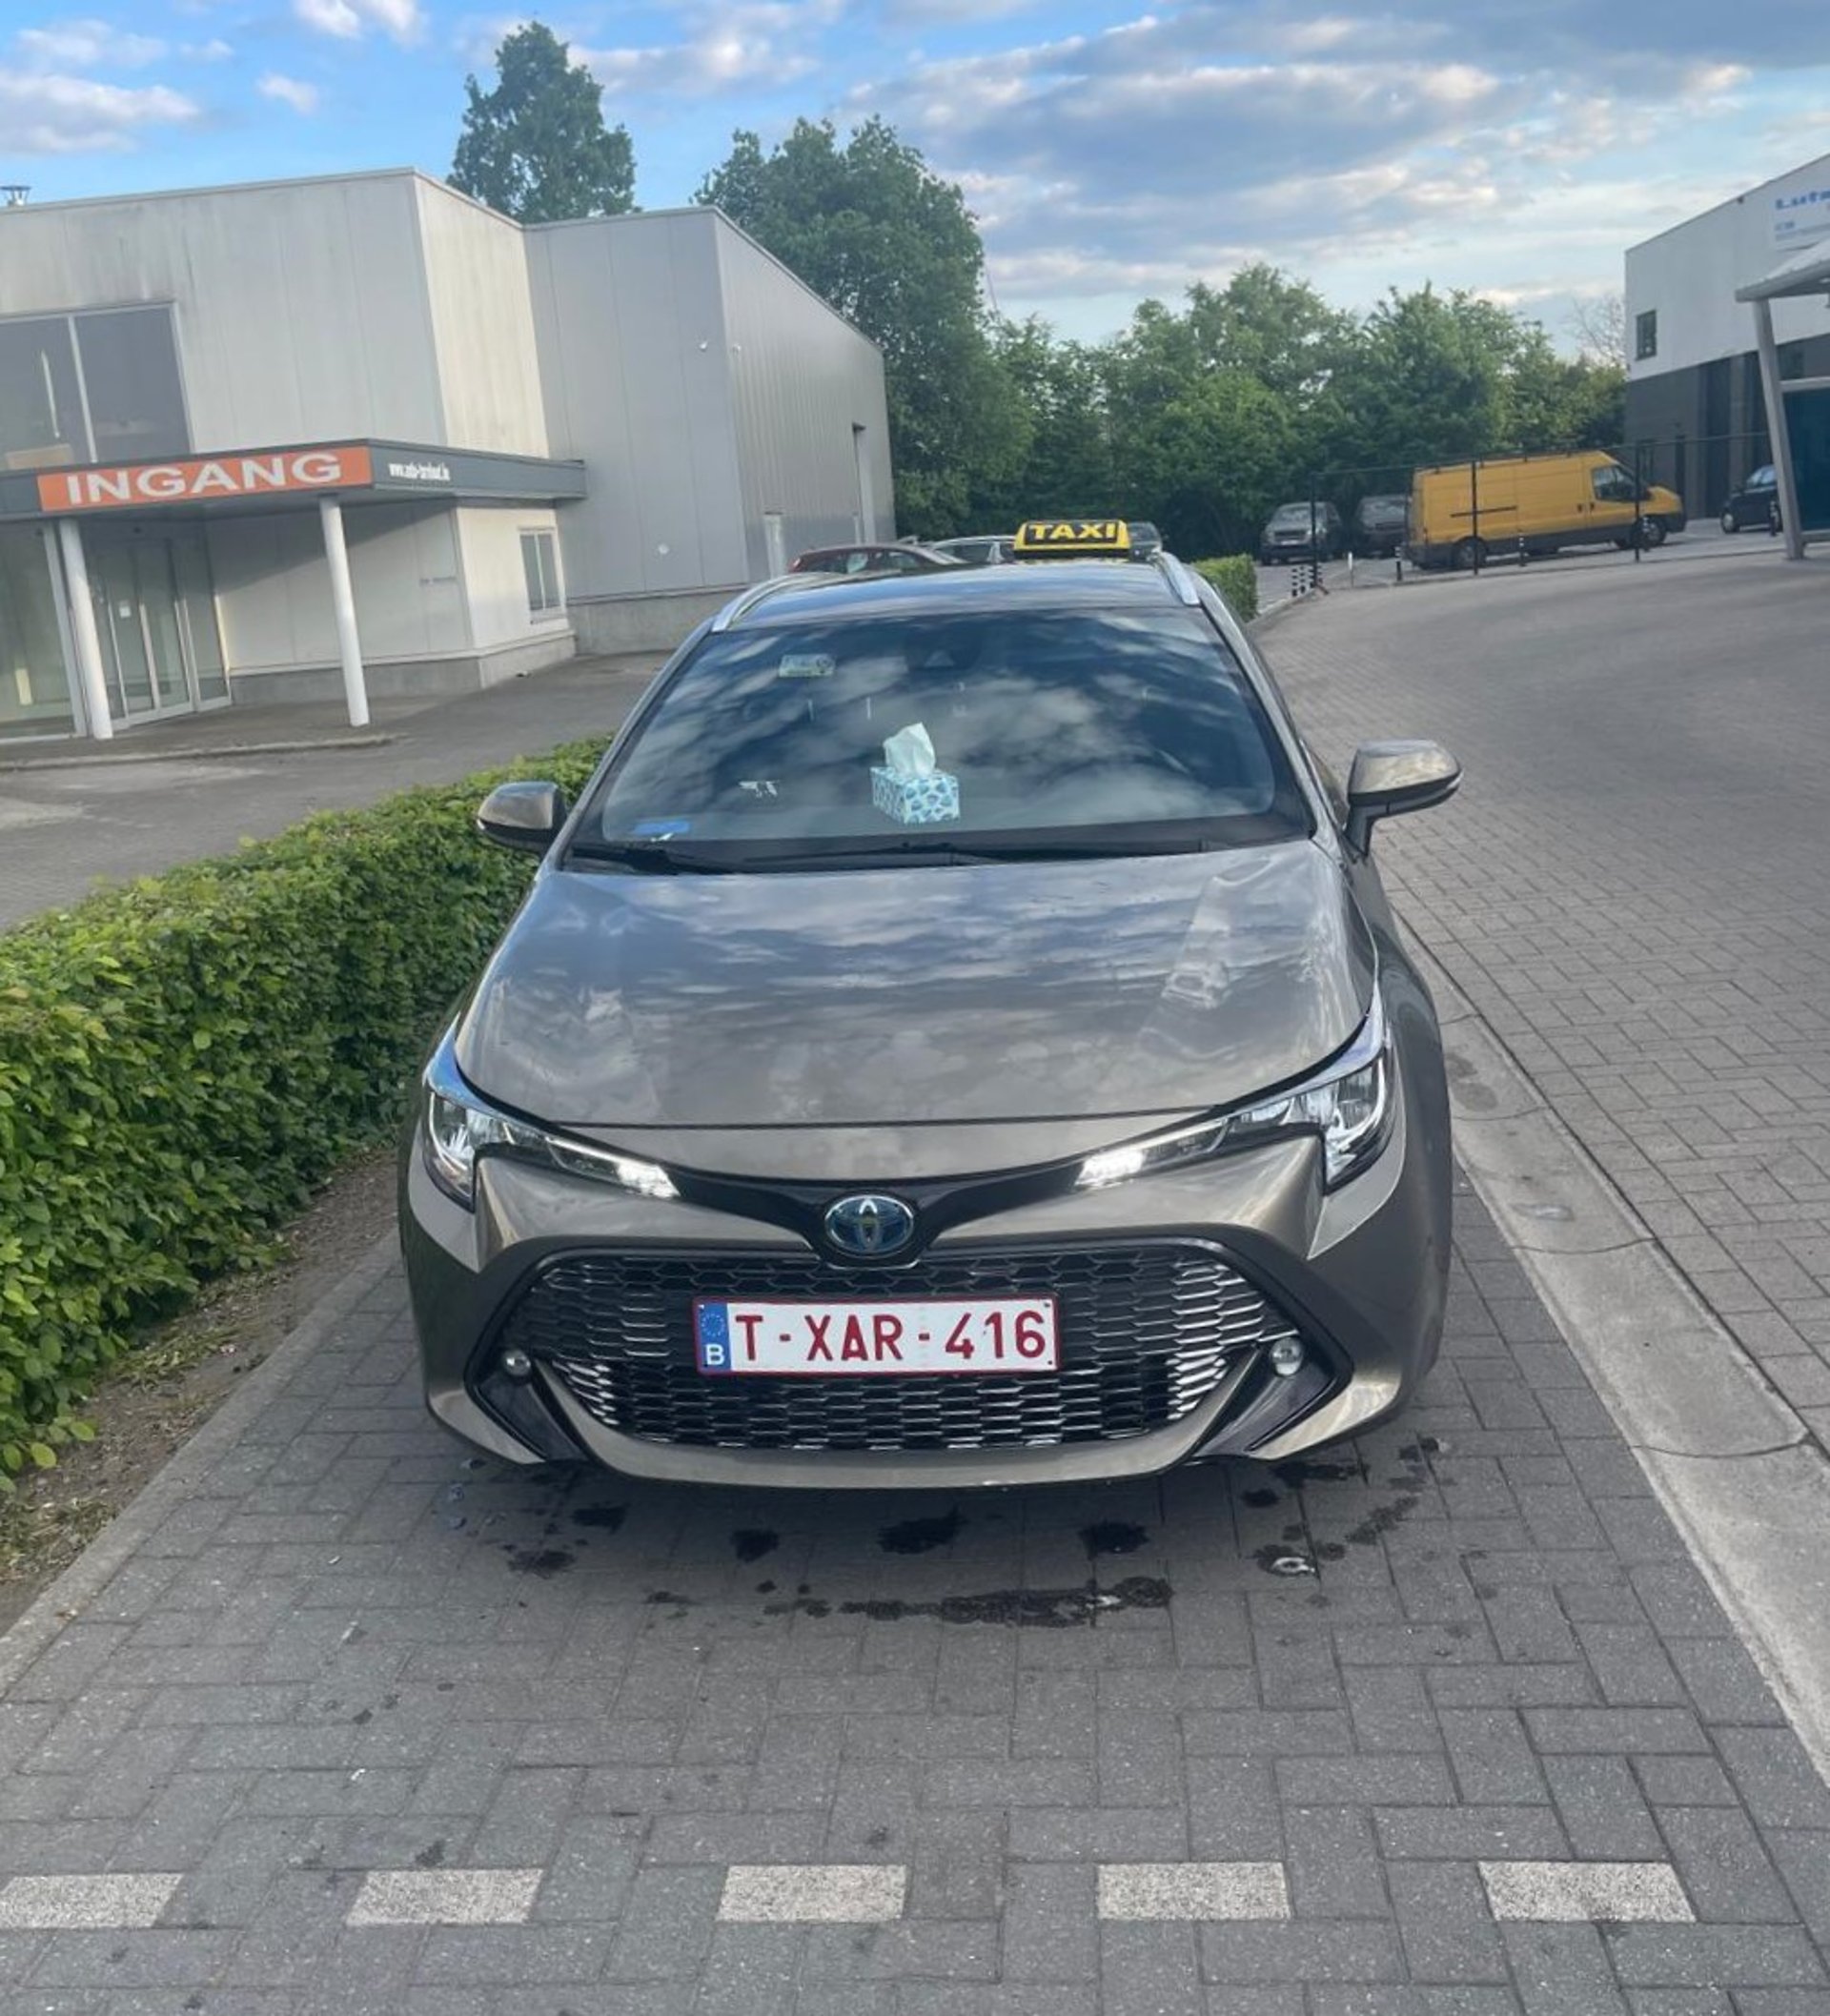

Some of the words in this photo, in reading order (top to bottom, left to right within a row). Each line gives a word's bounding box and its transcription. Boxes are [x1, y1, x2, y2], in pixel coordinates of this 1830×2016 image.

[67, 453, 341, 504] INGANG
[1028, 522, 1115, 540] TAXI
[735, 1310, 1047, 1361] T-XAR-416
[705, 1344, 725, 1366] B
